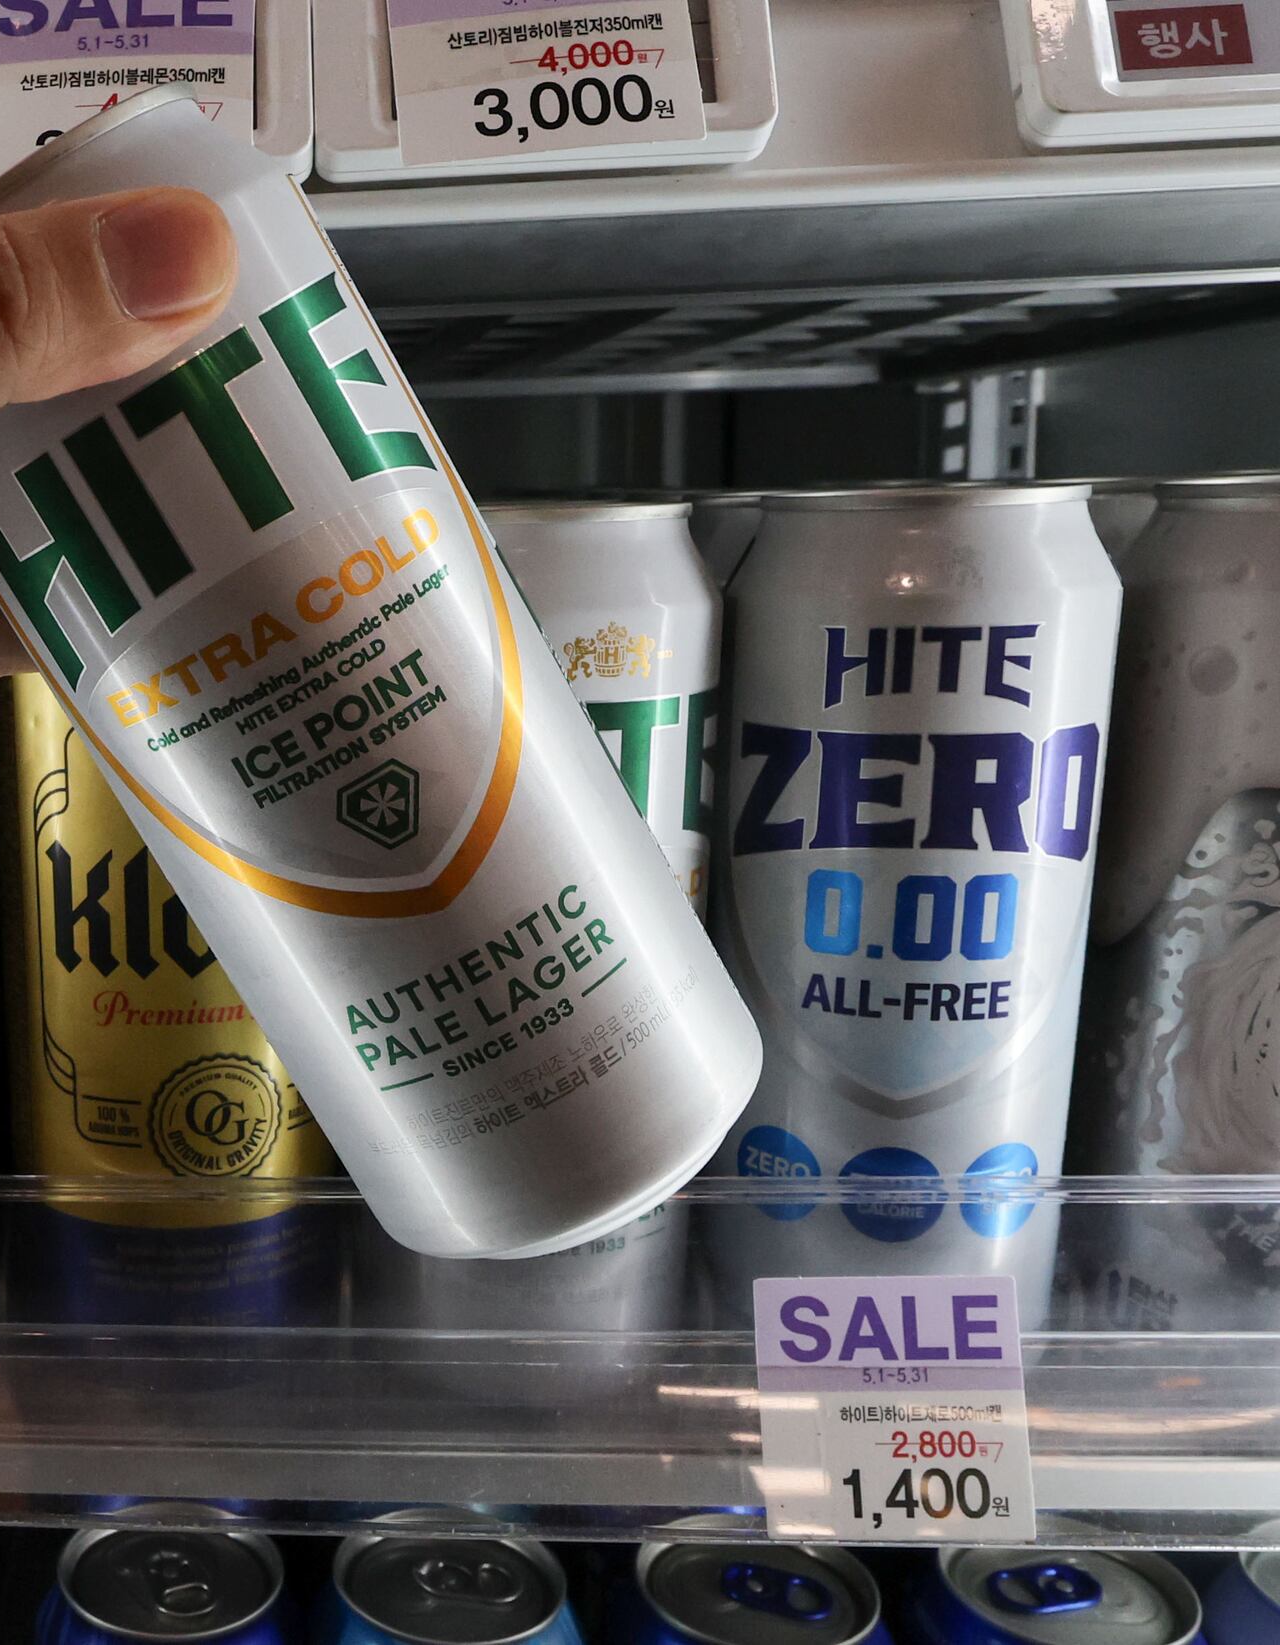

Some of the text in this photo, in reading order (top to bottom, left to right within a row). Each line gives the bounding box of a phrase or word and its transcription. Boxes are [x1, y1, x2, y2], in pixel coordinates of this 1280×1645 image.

[538, 40, 647, 75] 4,000원
[1137, 18, 1228, 59] 행사
[474, 74, 674, 143] 3,000원
[106, 508, 440, 728] EXTRA COLD
[147, 563, 450, 751] Cold and Refreshing Authentic Pale Lager
[235, 638, 386, 736] HITE EXTRA COLD
[823, 622, 1046, 712] HITE
[231, 648, 429, 788] ICE POINT
[253, 685, 448, 809] FILTRATION SYSTEM
[733, 721, 1101, 863] ZERO
[346, 884, 587, 1034] AUTHENTIC
[804, 868, 1019, 962] 0.00
[92, 989, 246, 1029] Premium
[356, 919, 615, 1071] PALE LAGER
[442, 997, 575, 1077] SINCE 1933
[801, 973, 1012, 1022] ALL-FREE
[475, 1103, 526, 1135] 하이트
[524, 1070, 591, 1112] 엑스트라
[590, 1047, 622, 1079] 콜드
[168, 1116, 268, 1170] ORIGINAL GRAVITY
[745, 1146, 811, 1178] ZERO
[779, 1294, 1003, 1363] SALE
[843, 1467, 1010, 1530] 1,400원
